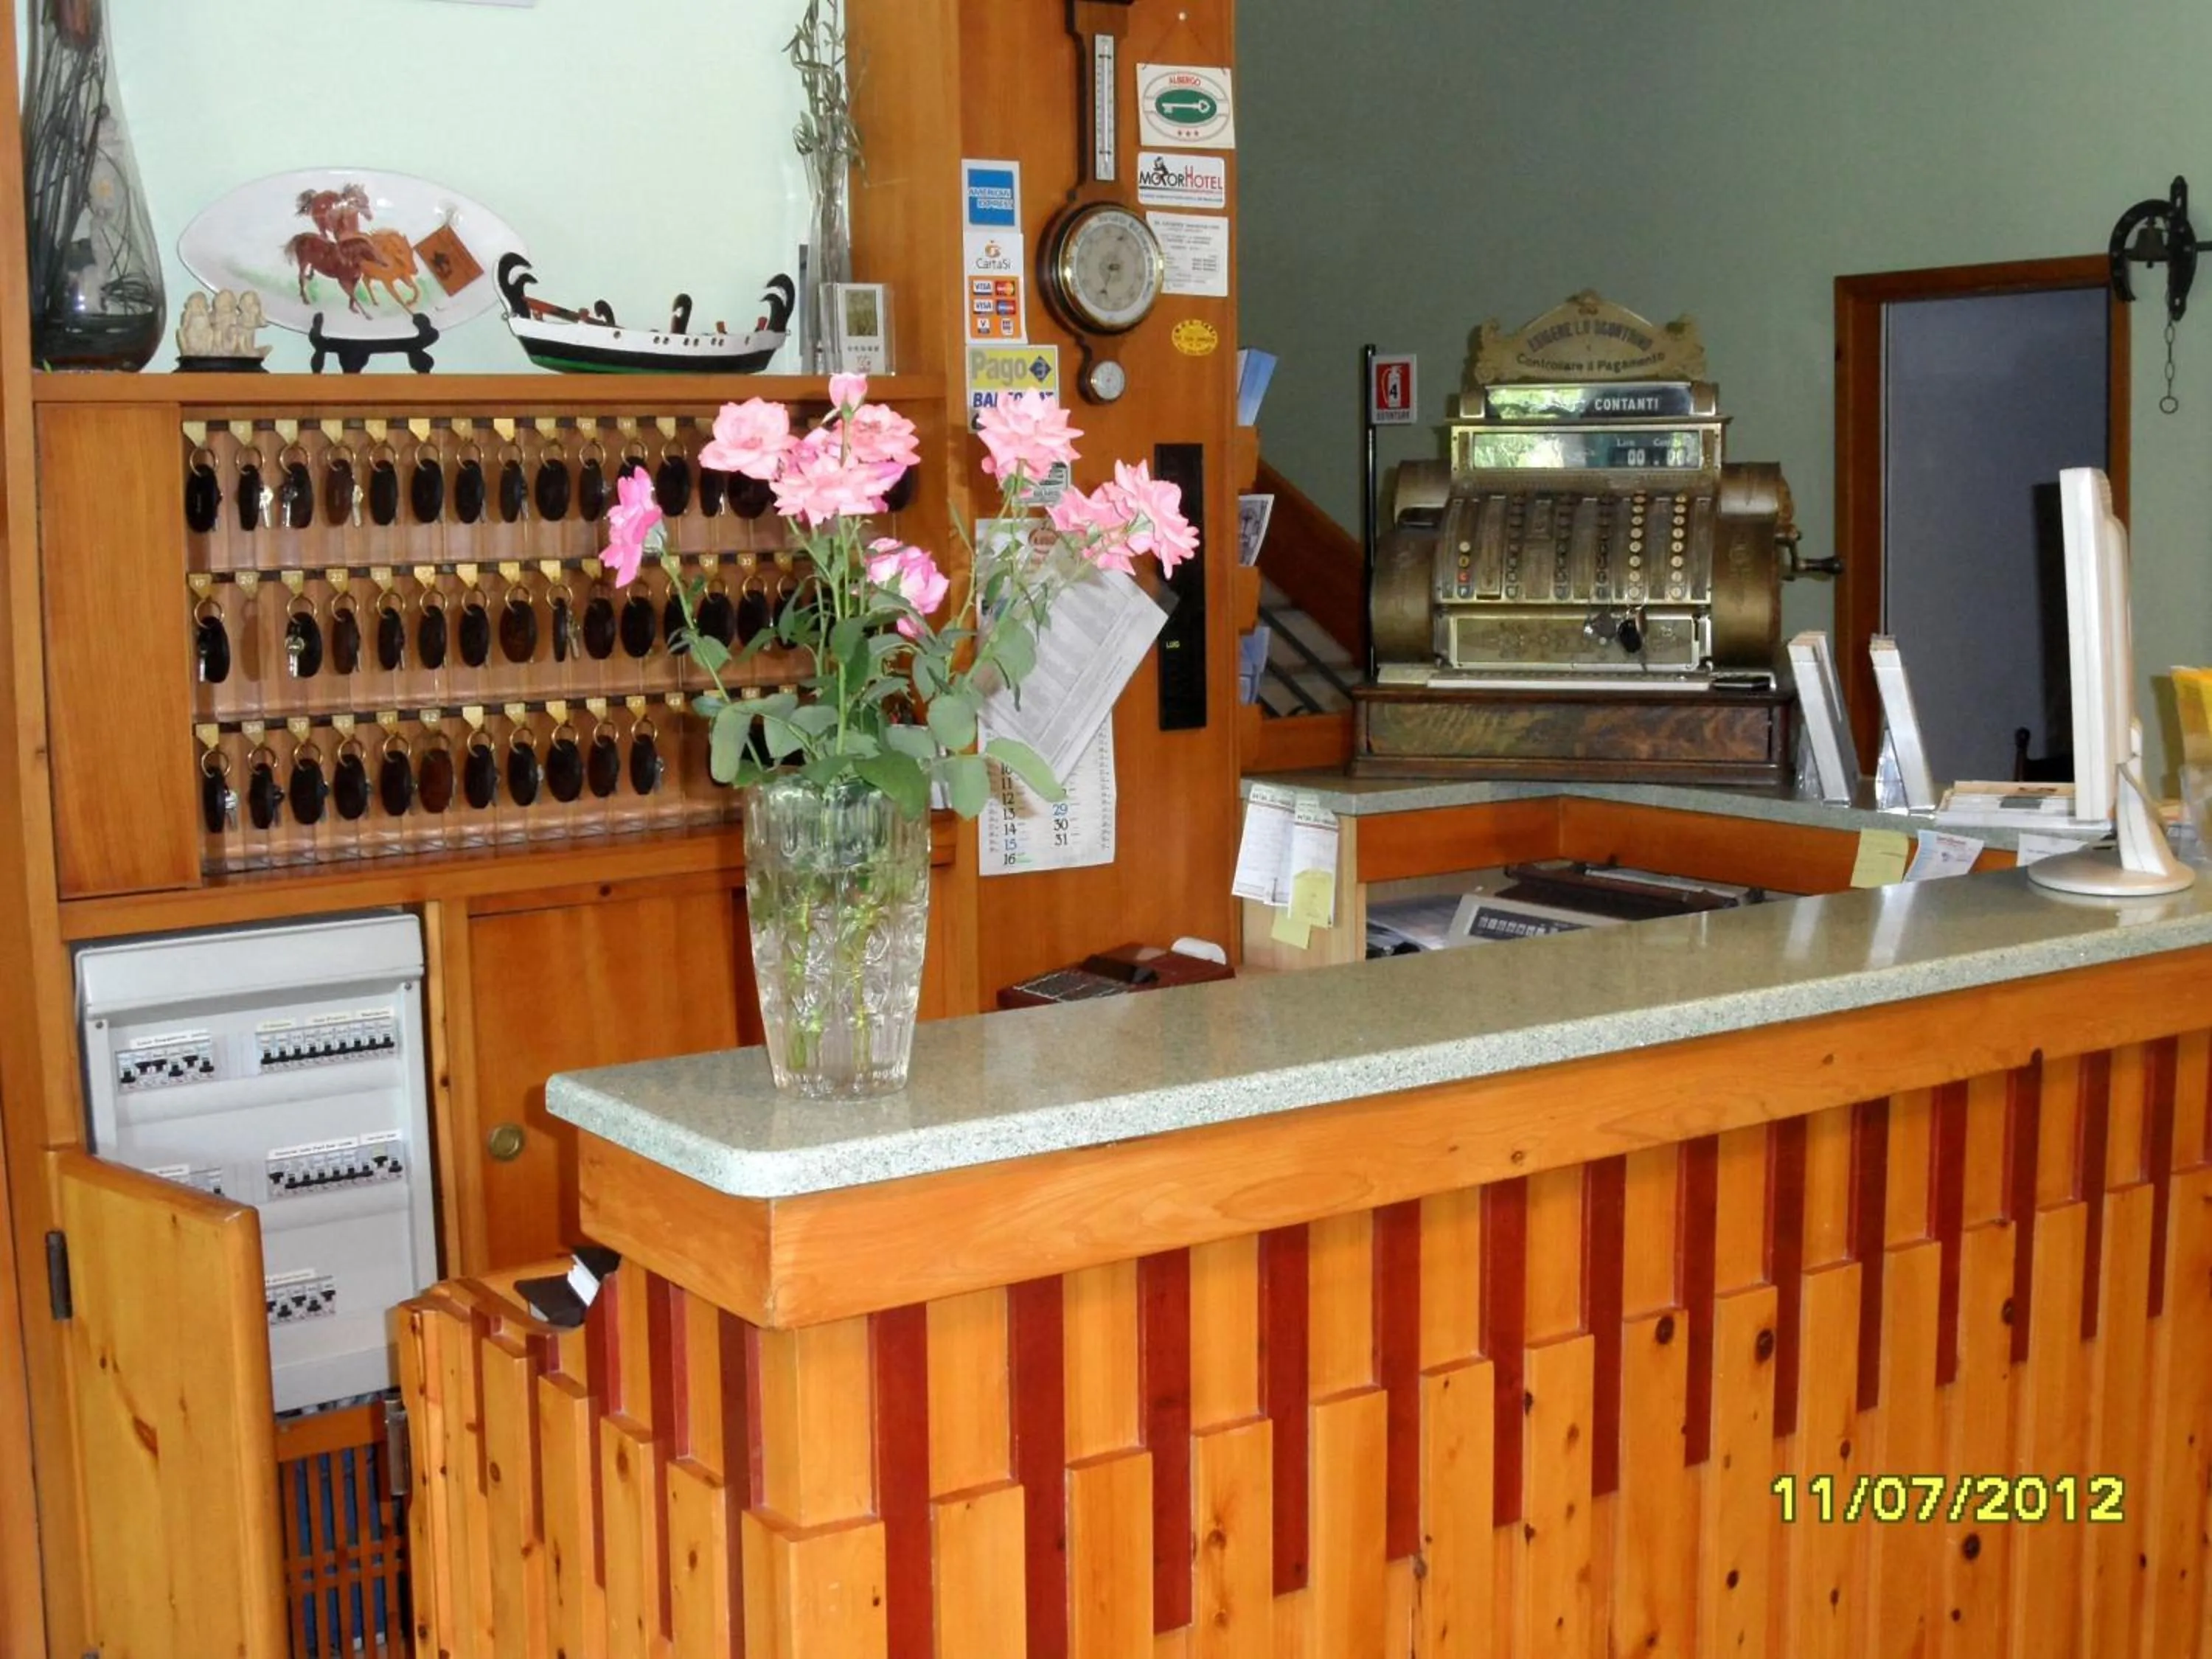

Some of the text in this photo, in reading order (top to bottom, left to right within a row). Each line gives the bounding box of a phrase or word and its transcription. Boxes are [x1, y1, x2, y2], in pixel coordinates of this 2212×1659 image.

[971, 350, 1028, 386] Pago
[1390, 383, 1397, 399] 4
[1594, 397, 1659, 411] CONTANTI
[1001, 778, 1012, 790] 11
[1002, 793, 1014, 805] 12
[1004, 808, 1015, 821] 13
[1052, 804, 1068, 816] 29
[1004, 824, 1016, 835] 14
[1054, 818, 1068, 831] 30
[1004, 838, 1017, 851] 15
[1054, 834, 1068, 846] 31
[1003, 854, 1016, 866] 16
